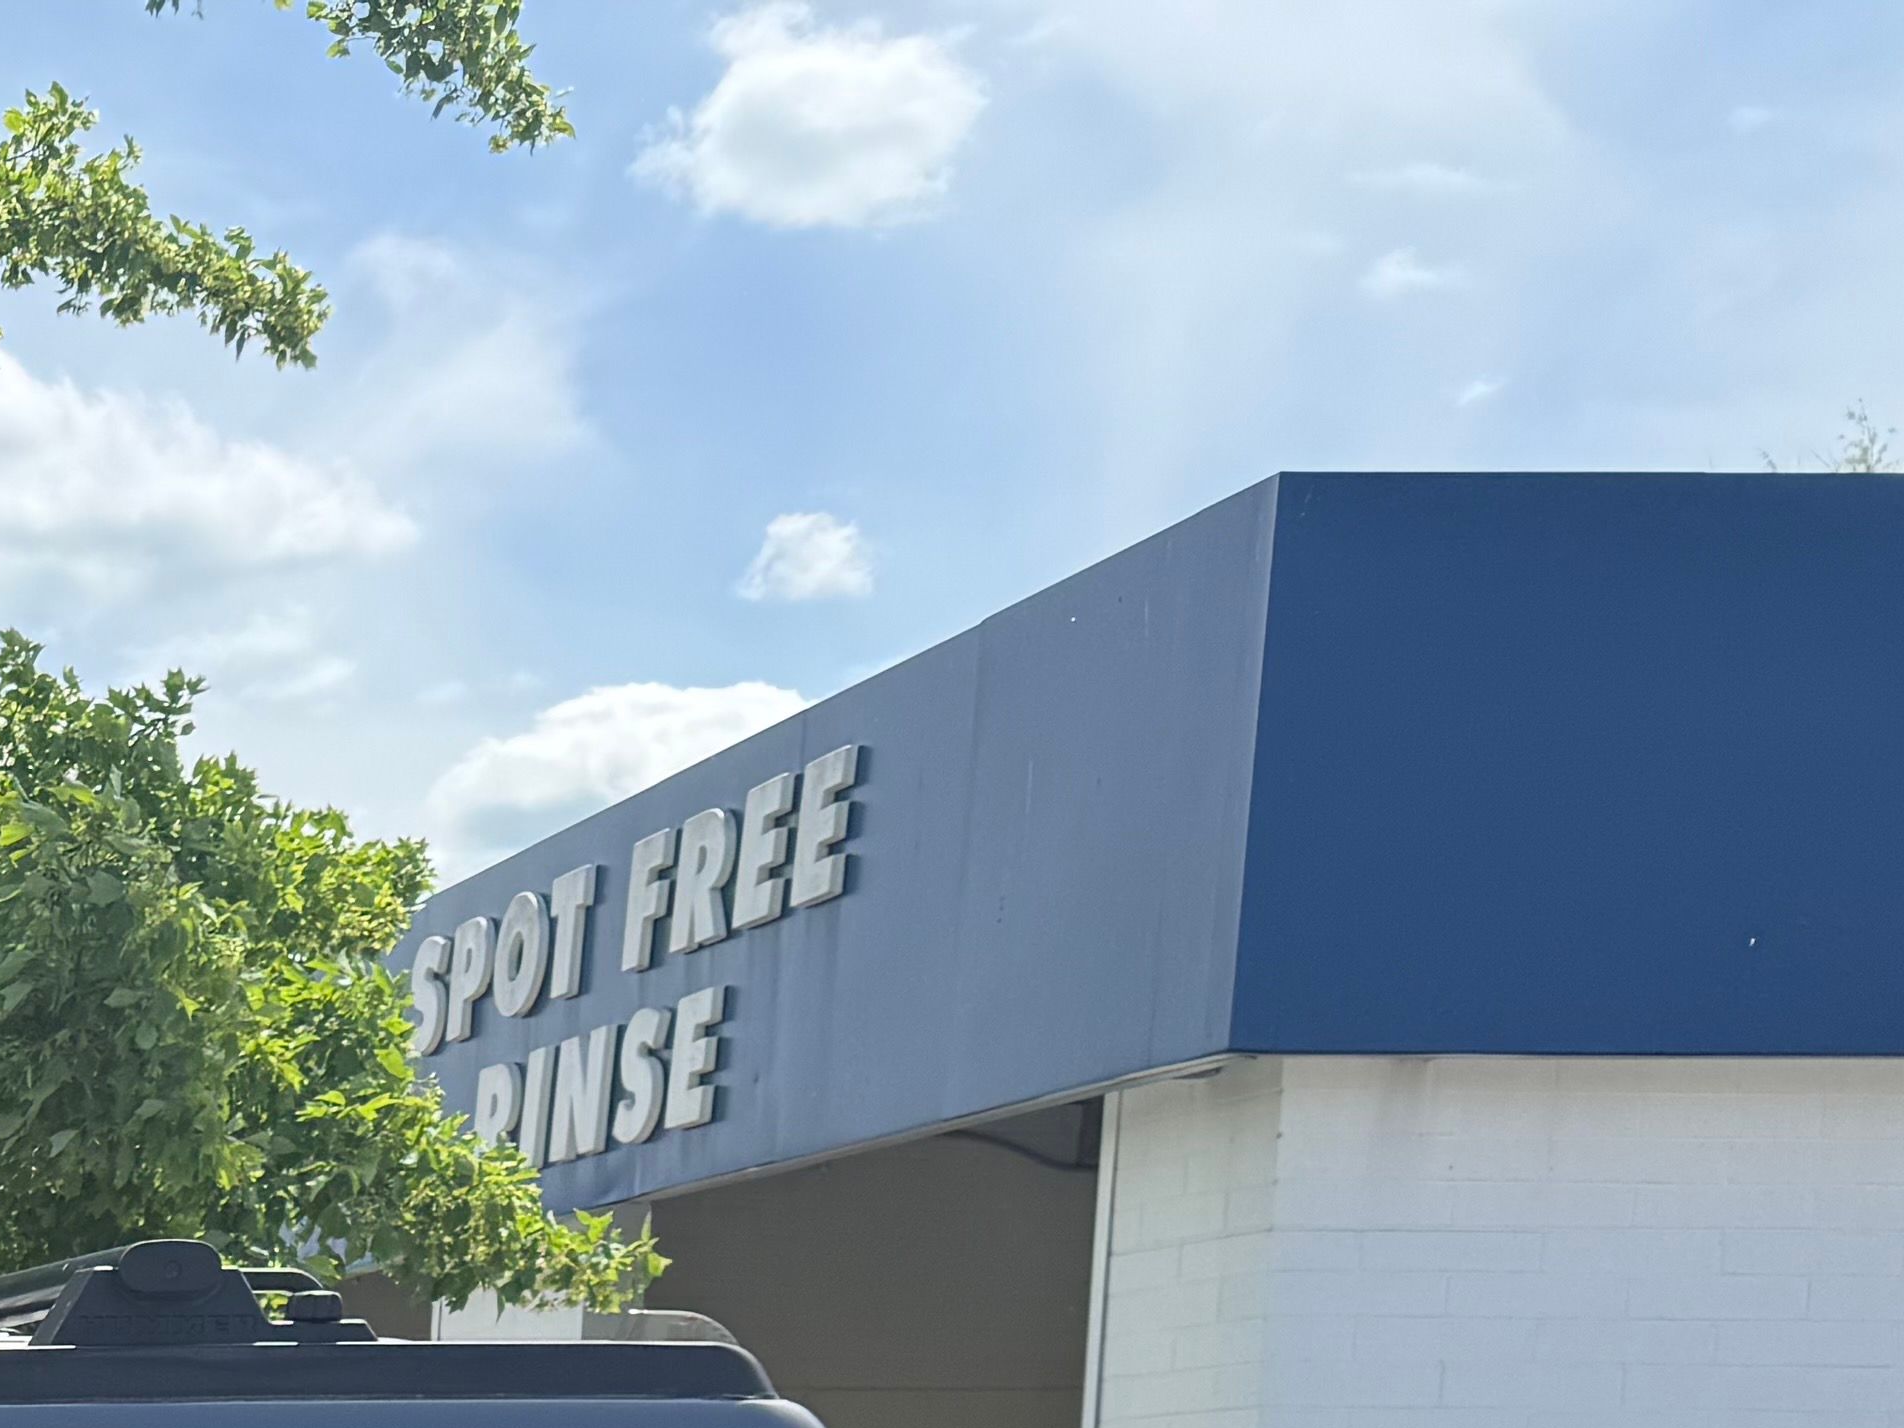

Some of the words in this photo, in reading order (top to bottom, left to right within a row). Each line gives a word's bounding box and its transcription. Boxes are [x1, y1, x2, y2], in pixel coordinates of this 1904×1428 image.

[410, 863, 598, 1056] SPOT
[621, 744, 861, 972] FREE
[474, 985, 728, 1169] RINSE
